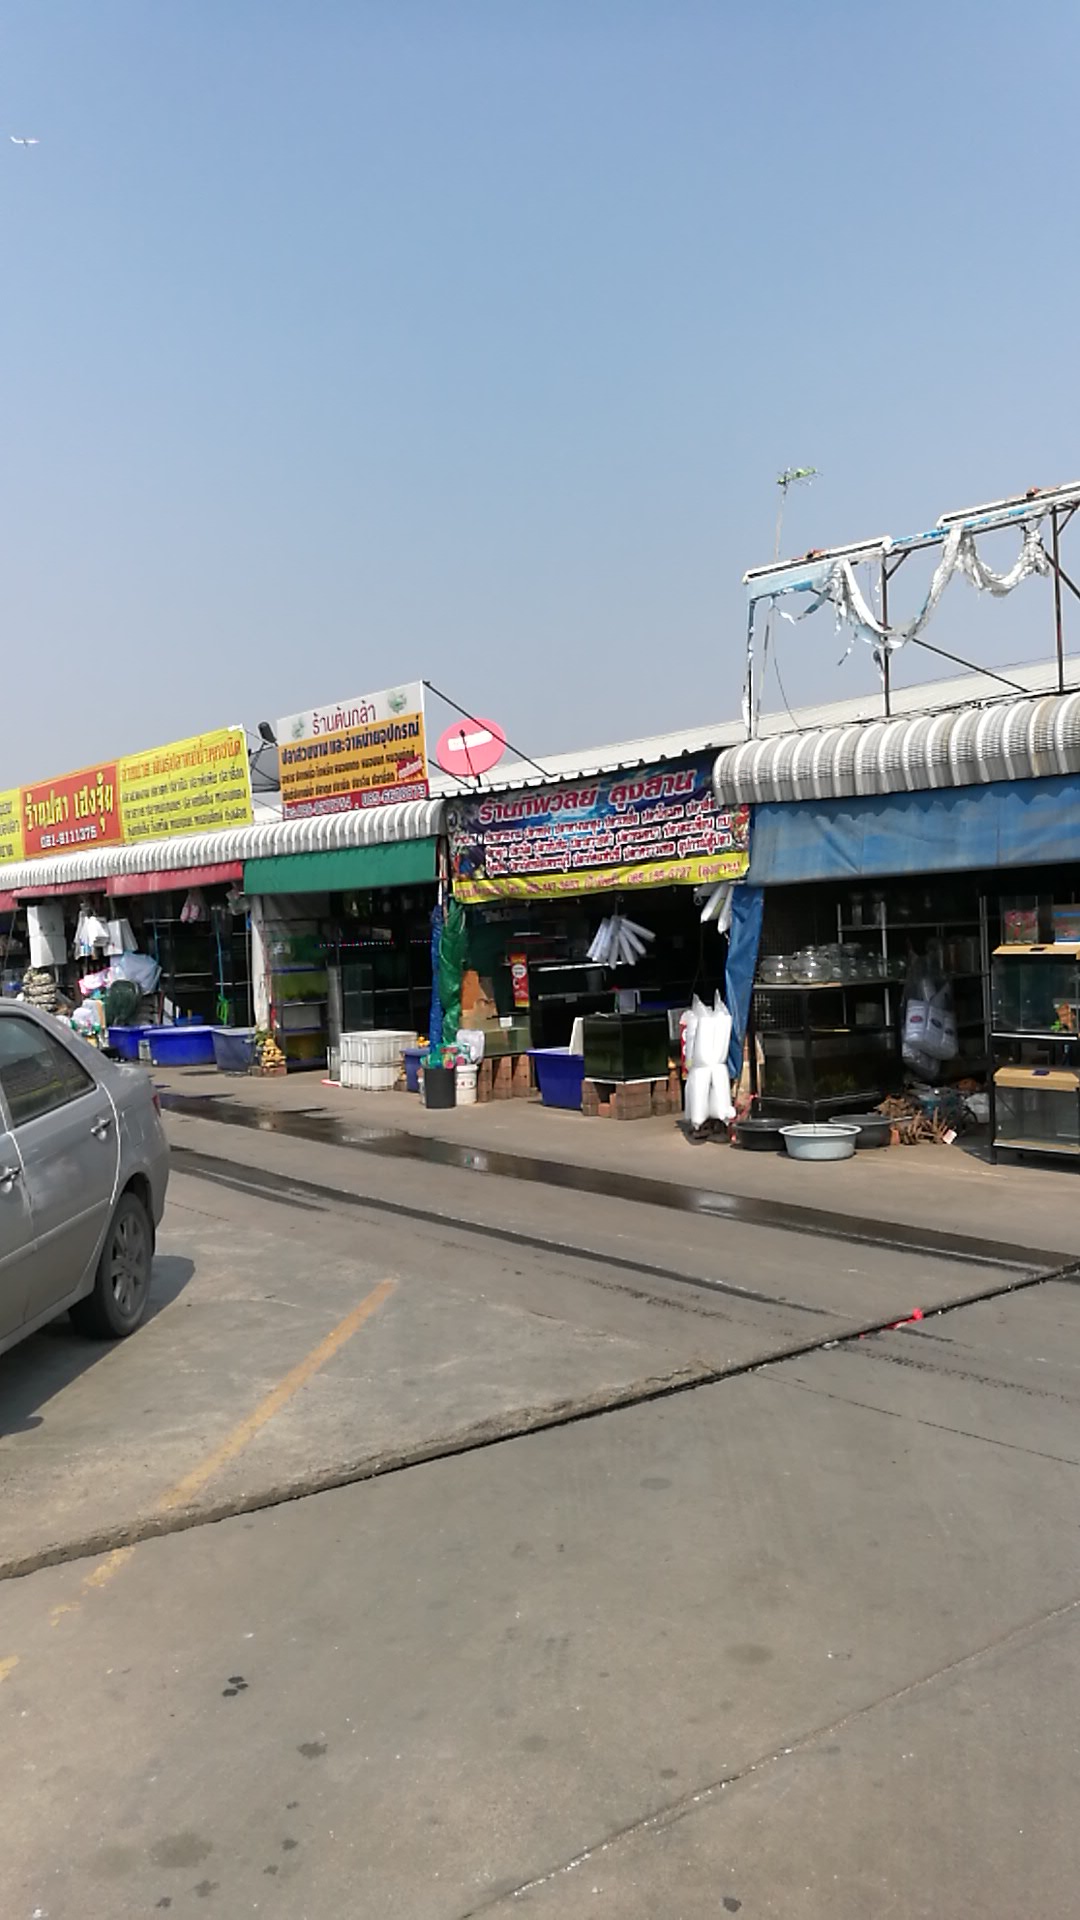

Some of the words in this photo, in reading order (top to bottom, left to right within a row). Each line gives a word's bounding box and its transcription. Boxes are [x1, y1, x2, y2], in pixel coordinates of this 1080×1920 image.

[312, 700, 377, 735] ร้านต้นกล้า
